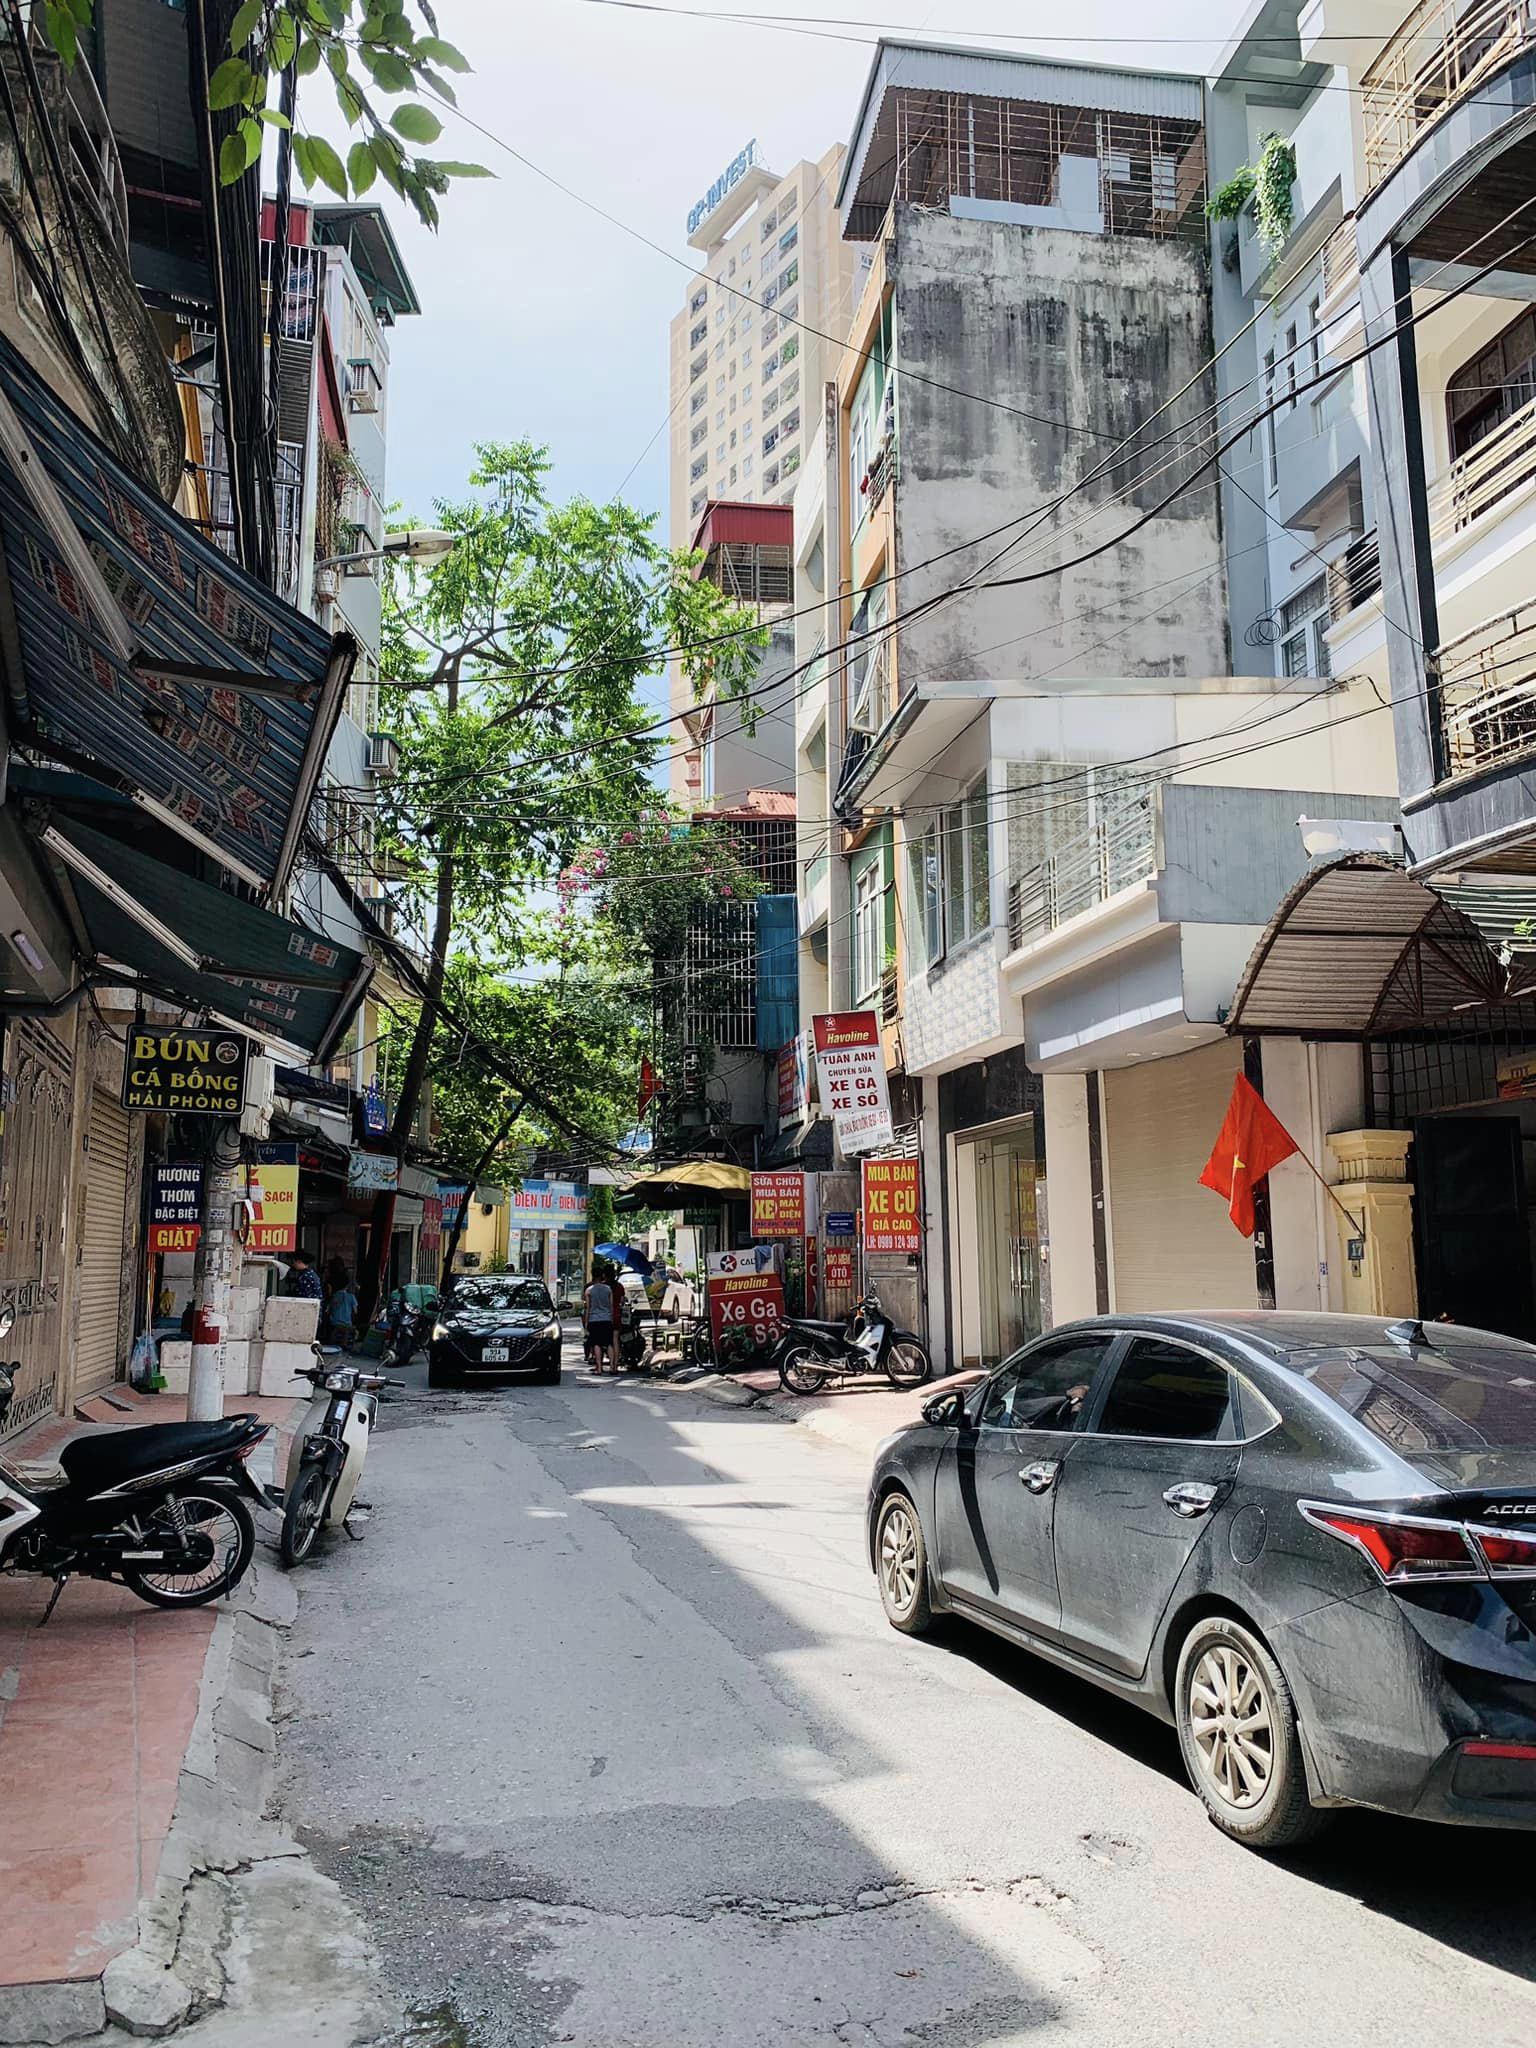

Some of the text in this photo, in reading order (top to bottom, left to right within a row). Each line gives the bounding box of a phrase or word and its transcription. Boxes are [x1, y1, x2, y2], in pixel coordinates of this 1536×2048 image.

[827, 1031, 869, 1044] Havoline
[134, 1031, 210, 1062] BÚN
[854, 1052, 876, 1062] ANH
[131, 1066, 239, 1091] CÁ BỐNG
[829, 1077, 877, 1092] XE GA
[129, 1090, 238, 1110] HẢI PHÒNG
[832, 1090, 879, 1110] XE SỐ
[157, 1168, 200, 1182] HƯƠNG
[867, 1162, 915, 1181] MUA BÁN
[160, 1188, 196, 1203] THƠM
[264, 1191, 294, 1205] SẠCH
[755, 1187, 800, 1197] MUA BÁN
[869, 1185, 916, 1214] XE CŨ
[754, 1199, 775, 1219] XE
[779, 1198, 800, 1208] MÁY
[154, 1207, 176, 1221] ĐẶC
[178, 1207, 199, 1221] BIỆT
[872, 1217, 912, 1231] GIÁ CAO
[157, 1227, 195, 1250] GIẶT
[261, 1228, 289, 1246] HƠI
[894, 1234, 906, 1249] 124
[740, 1258, 756, 1266] CAL
[724, 1277, 769, 1292] Havoline
[720, 1297, 777, 1322] Xe Ga
[1482, 1505, 1536, 1514] ACCE
